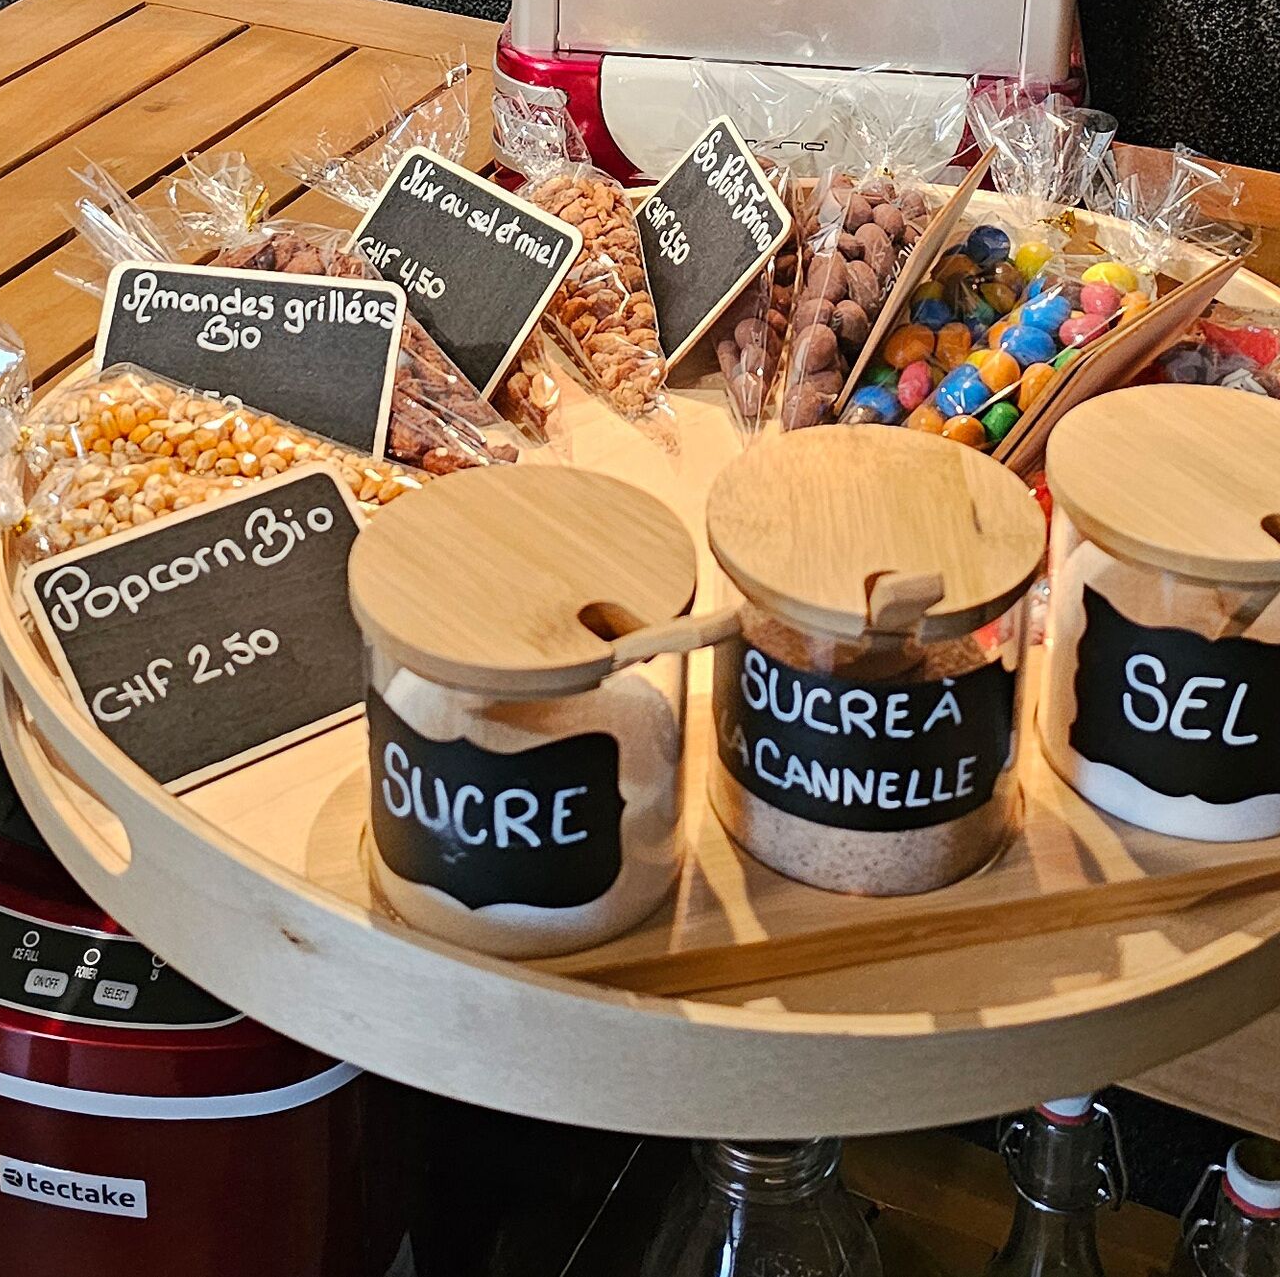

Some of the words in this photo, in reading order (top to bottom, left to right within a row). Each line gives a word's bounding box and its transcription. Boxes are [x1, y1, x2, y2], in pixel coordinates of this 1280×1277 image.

[644, 197, 676, 232] CHF
[693, 130, 722, 172] So
[732, 183, 773, 253] Torino
[439, 192, 469, 218] au
[467, 207, 500, 238] sel
[495, 215, 521, 245] et
[514, 234, 564, 269] miel
[658, 223, 691, 266] 3,50
[357, 237, 402, 269] CHF
[399, 257, 446, 299] 4,50
[122, 272, 274, 324] Amandes
[283, 290, 398, 335] grillées
[196, 315, 262, 352] Bio
[44, 538, 246, 631] Popcorn
[245, 507, 334, 567] Bio
[91, 658, 173, 722] CHF
[187, 628, 280, 685] 2,50
[741, 649, 915, 739] SUCRE
[1122, 653, 1259, 746] SEL
[382, 741, 588, 848] SUCRE
[755, 737, 977, 809] CANNELLE
[12, 947, 25, 961] ICE
[22, 949, 40, 963] FULL
[73, 965, 99, 980] POWER
[102, 986, 130, 1002] SELECT
[26, 1172, 136, 1208] tectake
